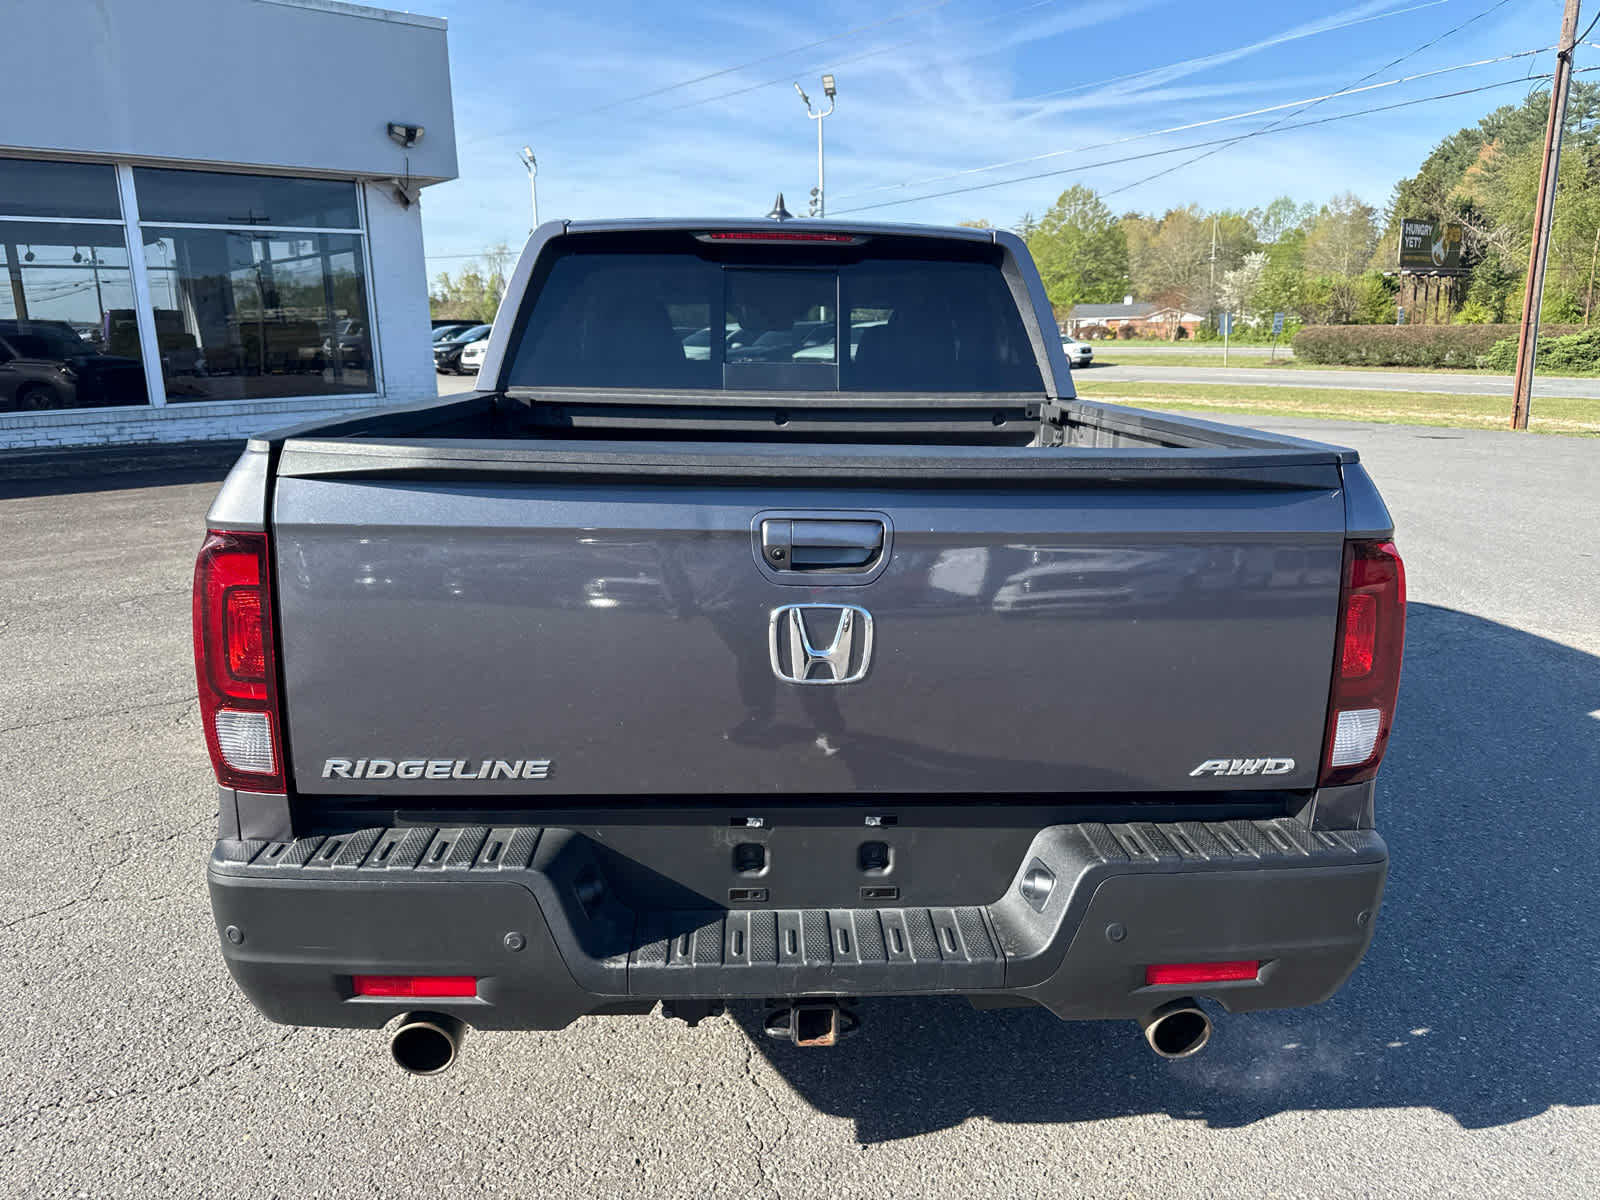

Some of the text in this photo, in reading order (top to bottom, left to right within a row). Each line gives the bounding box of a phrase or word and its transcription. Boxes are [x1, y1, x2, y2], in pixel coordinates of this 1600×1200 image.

[1405, 223, 1433, 236] HUNGRY
[1405, 236, 1422, 248] YET?
[321, 759, 551, 779] RIDGELINE
[1189, 758, 1295, 776] AWD
